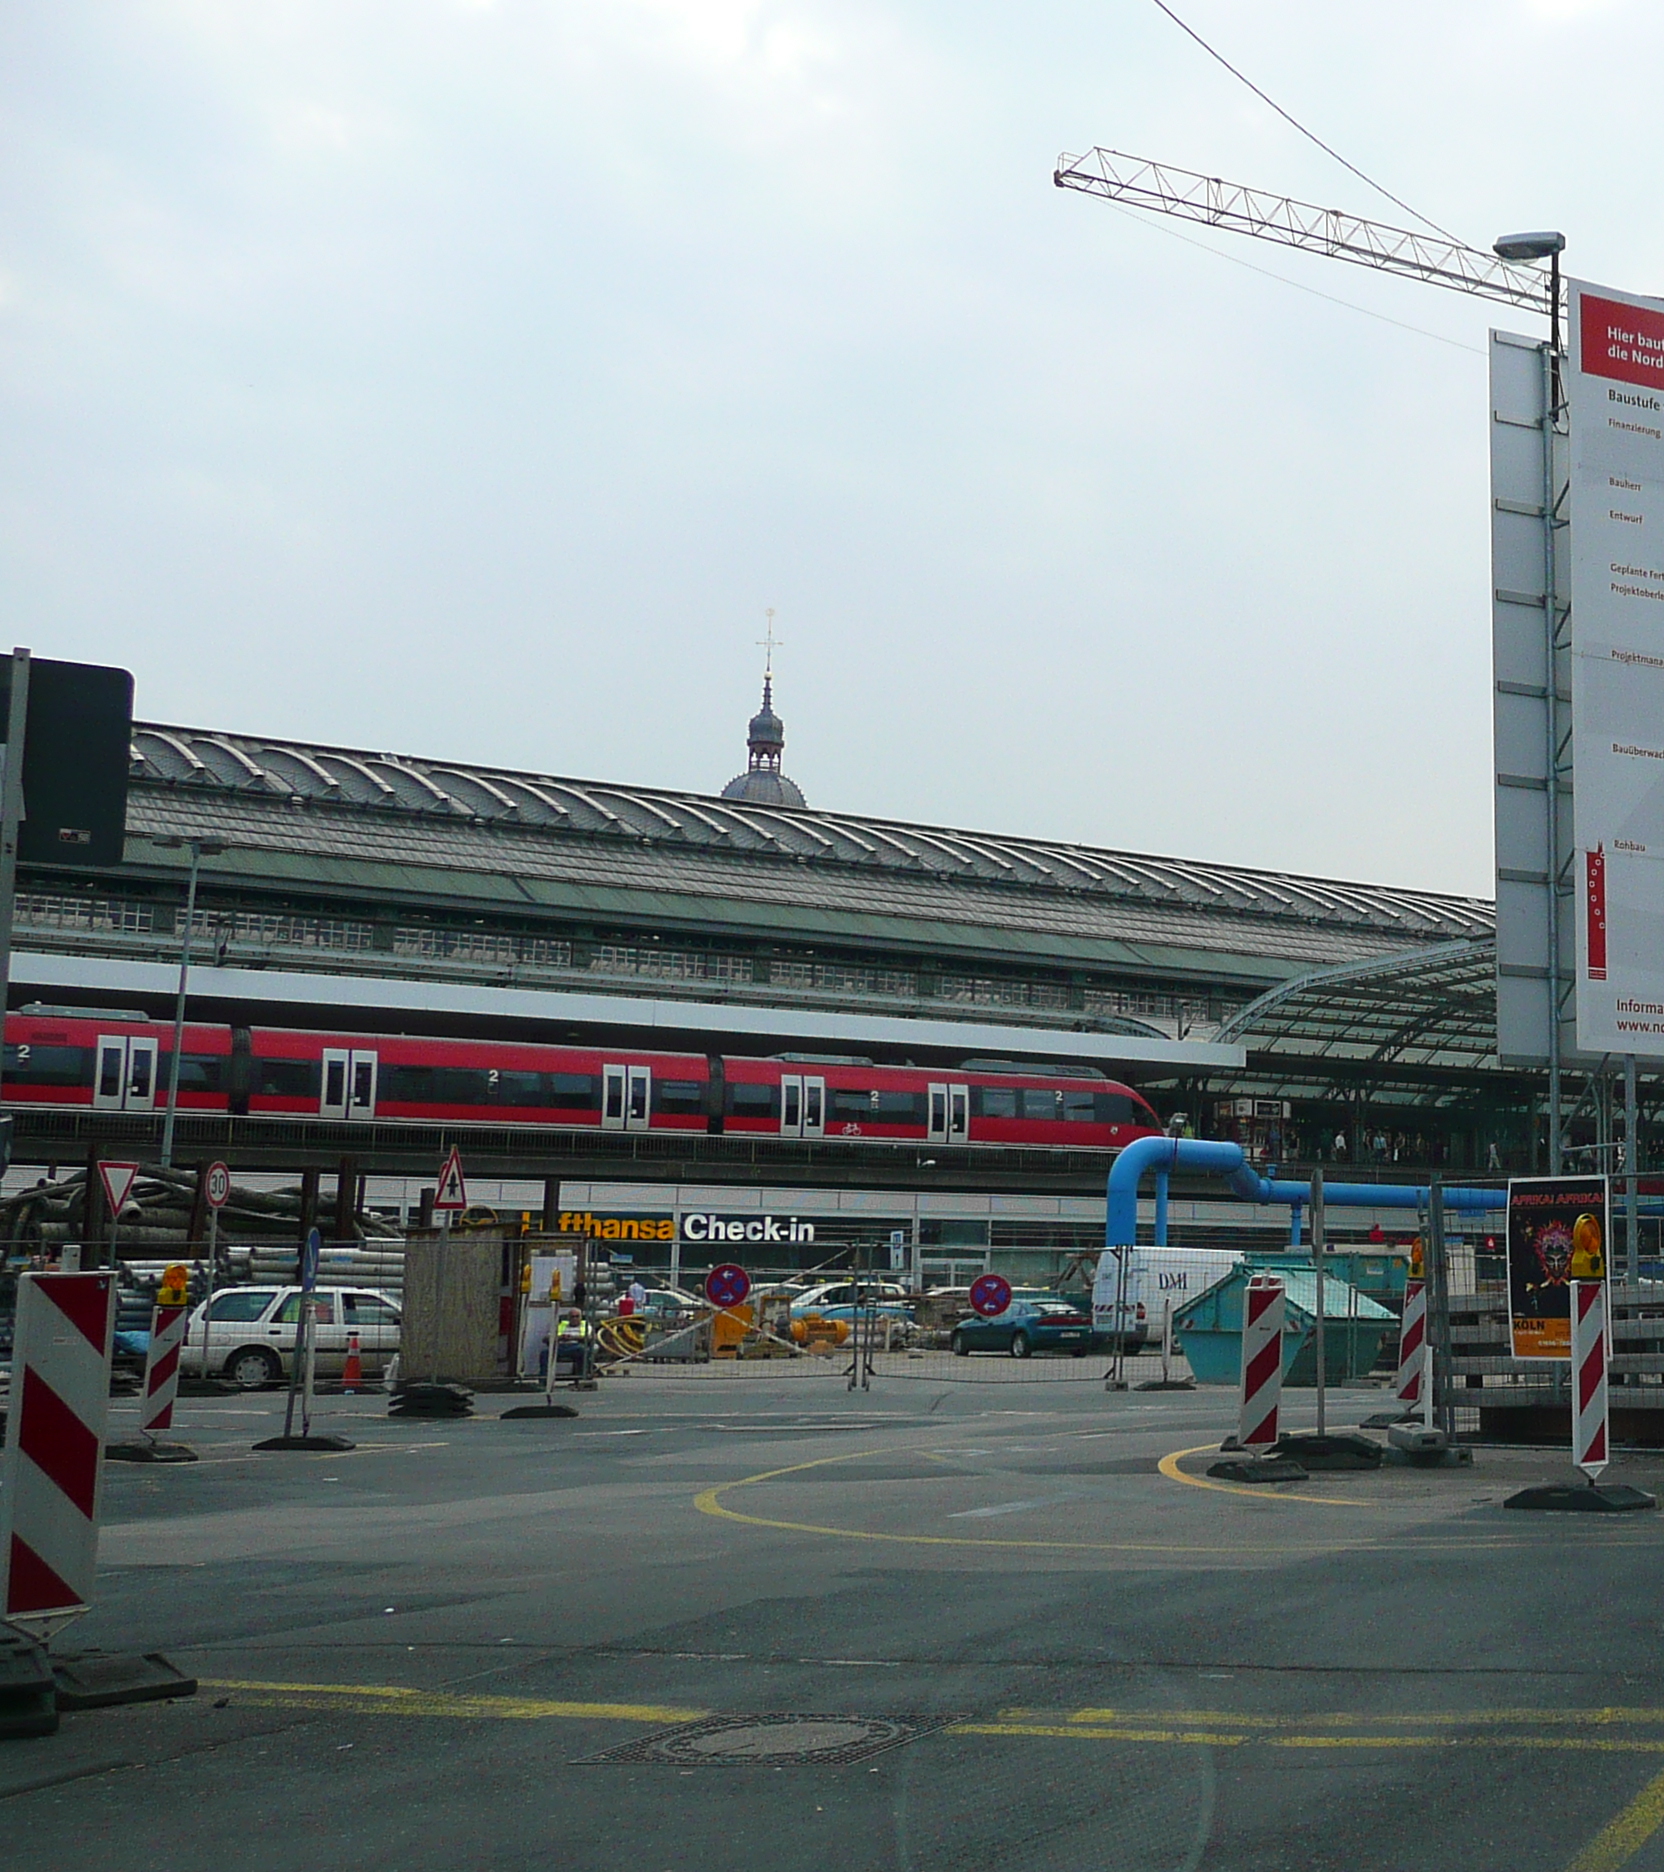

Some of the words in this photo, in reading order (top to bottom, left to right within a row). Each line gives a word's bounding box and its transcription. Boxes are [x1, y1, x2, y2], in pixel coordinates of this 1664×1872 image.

[1607, 326, 1634, 344] Hier
[1608, 345, 1628, 360] die
[1608, 389, 1660, 411] Baustufe
[1608, 418, 1661, 439] Finanzierung
[1609, 509, 1644, 525] Entwurf
[1610, 563, 1648, 578] Geplante
[1613, 839, 1646, 852] Rohbau
[17, 1044, 31, 1058] 2
[488, 1069, 499, 1082] 2
[870, 1090, 879, 1101] 2
[1055, 1090, 1063, 1101] 2
[211, 1174, 226, 1195] 30
[1556, 1192, 1604, 1204] AFRIKA!
[522, 1211, 676, 1241] Lfthansa
[684, 1213, 815, 1242] Check-in
[1159, 1272, 1188, 1290] DMI
[1513, 1318, 1545, 1330] KÖLN
